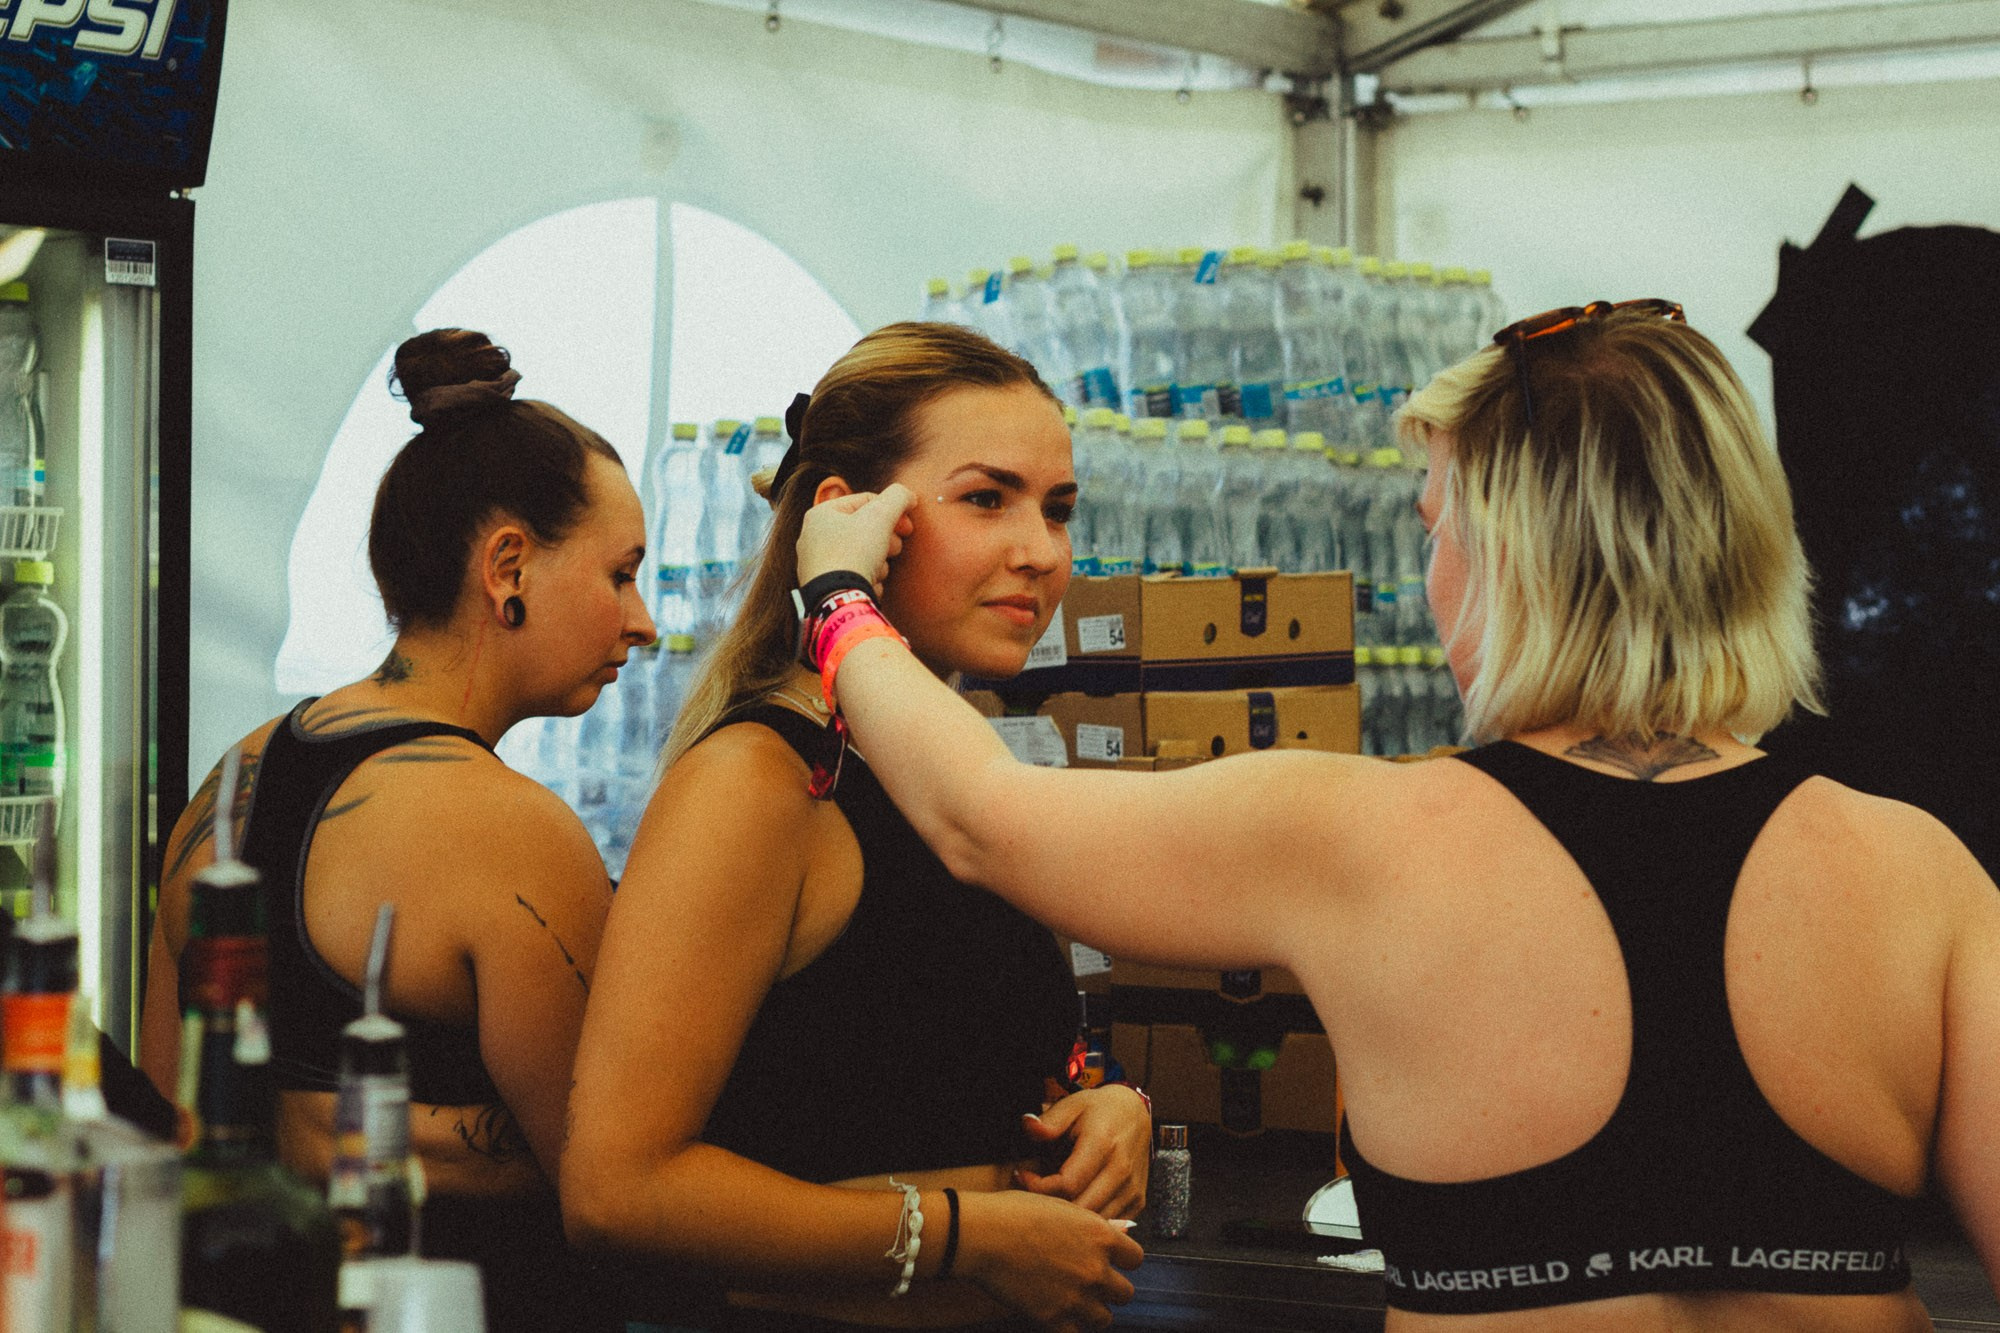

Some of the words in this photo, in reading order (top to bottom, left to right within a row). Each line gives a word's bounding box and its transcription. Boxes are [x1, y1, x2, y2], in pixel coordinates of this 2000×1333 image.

[0, 0, 178, 60] PSI
[1109, 629, 1124, 646] 54
[1106, 740, 1121, 757] 54
[1384, 1264, 1407, 1288] RL
[1412, 1261, 1570, 1291] LAGERFELD
[1629, 1247, 1713, 1272] KARL
[1731, 1247, 1886, 1272] LAGERFELD
